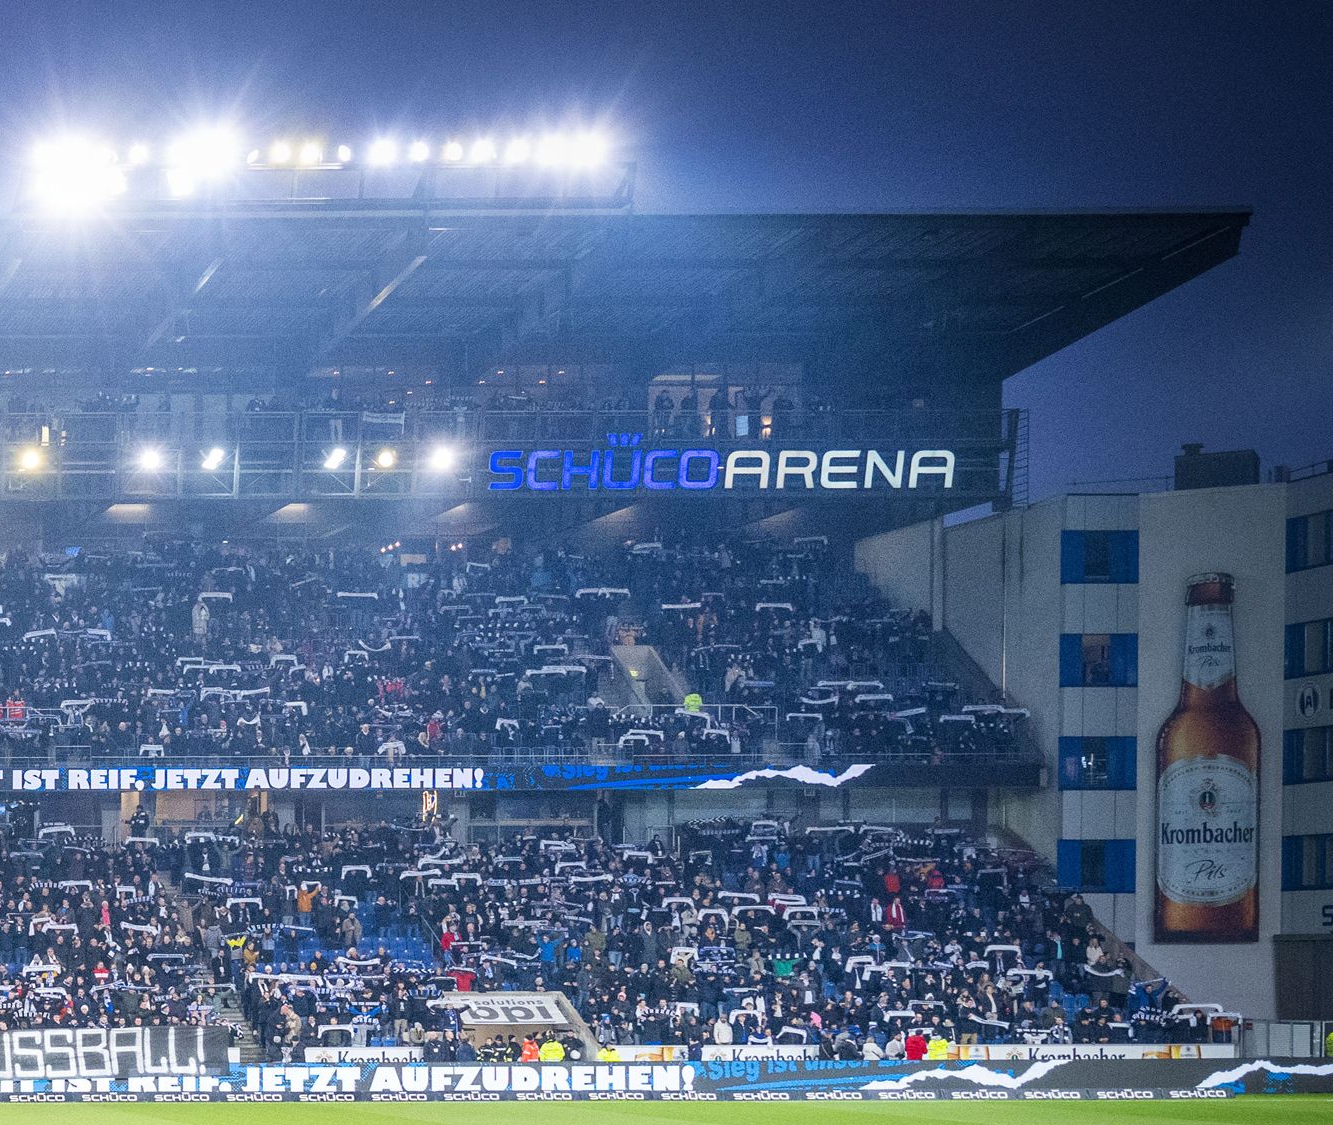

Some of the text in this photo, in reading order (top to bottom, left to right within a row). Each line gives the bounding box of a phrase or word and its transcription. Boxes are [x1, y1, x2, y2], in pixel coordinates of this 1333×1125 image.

[488, 433, 956, 490] SCHÜCOARENA
[12, 769, 60, 791] IST
[151, 768, 240, 791] JETZT
[244, 767, 484, 790] AUFZUDREHEN!
[1161, 821, 1255, 845] Krombacher
[1184, 859, 1228, 881] Pils
[473, 998, 544, 1006] solutions
[338, 1050, 426, 1063] Krombache
[732, 1048, 821, 1061] Krombache
[246, 1066, 362, 1092] JETZT
[368, 1065, 696, 1092] AUFZUDREHEN!
[9, 1092, 66, 1103] SCHÜCO
[81, 1092, 138, 1103] SCHÜCO
[153, 1092, 210, 1103] SCHÜCO
[226, 1092, 283, 1103] SCHÜCO
[298, 1092, 355, 1103] SCHÜCO
[371, 1091, 428, 1102] SCHÜCO
[443, 1091, 500, 1102] SCHÜCO
[515, 1090, 573, 1101] SCHÜCO
[588, 1090, 645, 1101] SCHÜCO
[660, 1090, 718, 1101] SCHÜCO
[732, 1089, 790, 1100] SCHÜCO
[805, 1089, 863, 1100] SCHÜCO
[877, 1089, 936, 1100] SCHÜCO
[951, 1089, 1009, 1100] SCHÜCO
[1023, 1088, 1081, 1099] SCHÜCO
[1096, 1088, 1154, 1099] SCHÜCO
[1169, 1088, 1227, 1099] SCHÜCO
